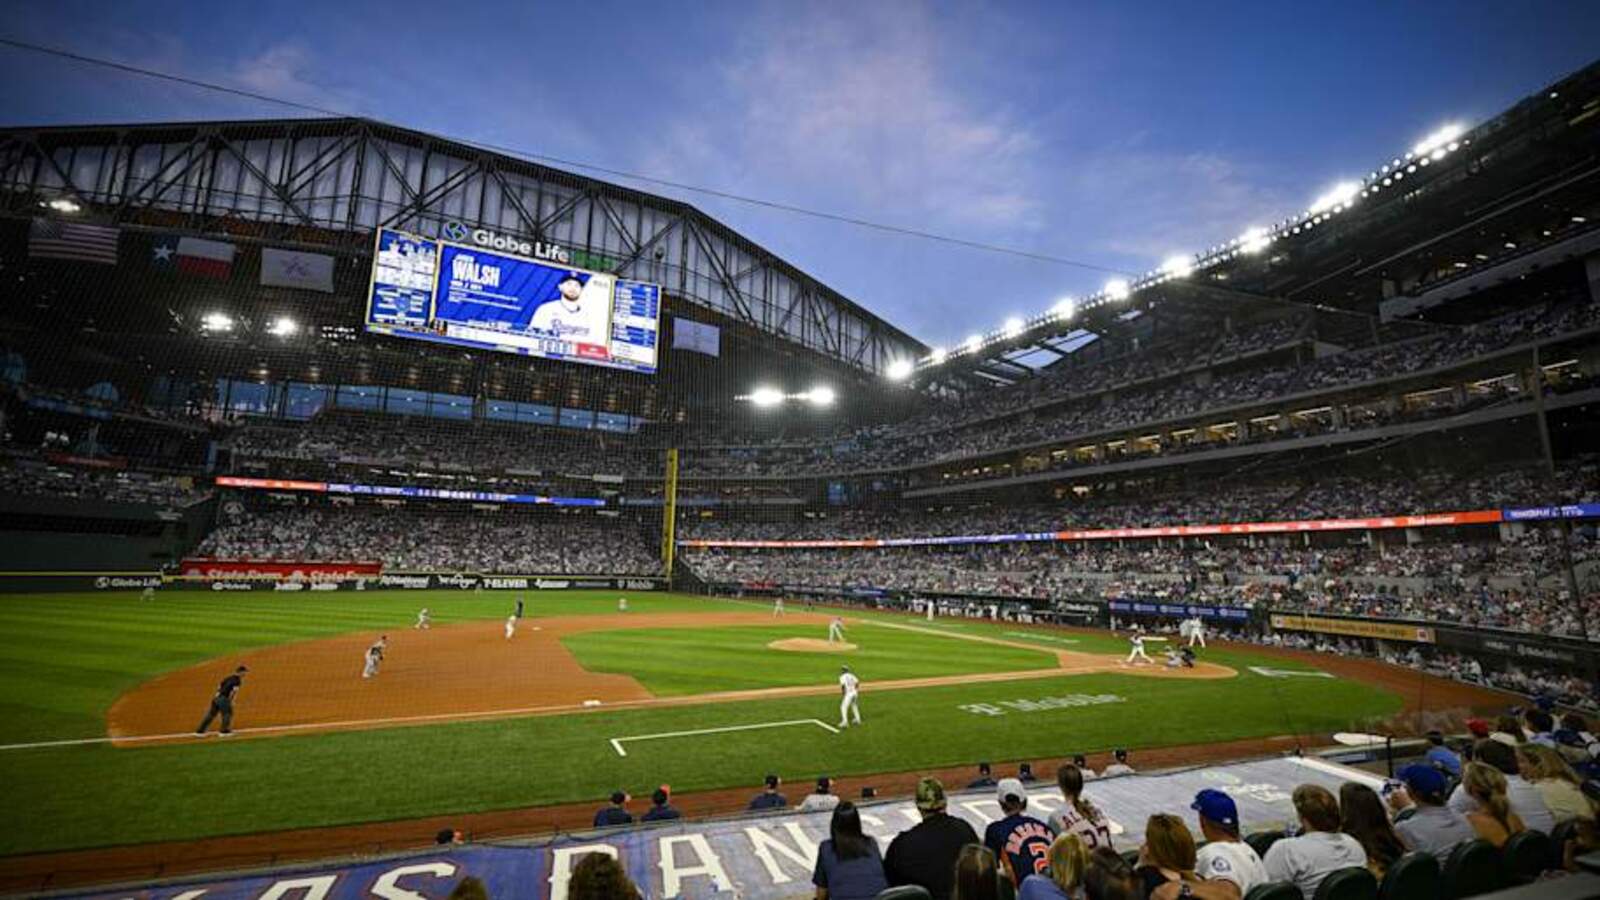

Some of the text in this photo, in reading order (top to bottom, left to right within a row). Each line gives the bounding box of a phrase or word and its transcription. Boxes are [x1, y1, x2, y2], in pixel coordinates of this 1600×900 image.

[472, 229, 532, 255] Globe
[535, 241, 570, 263] Life
[452, 258, 501, 288] WALSH
[111, 577, 162, 588] Globe Life
